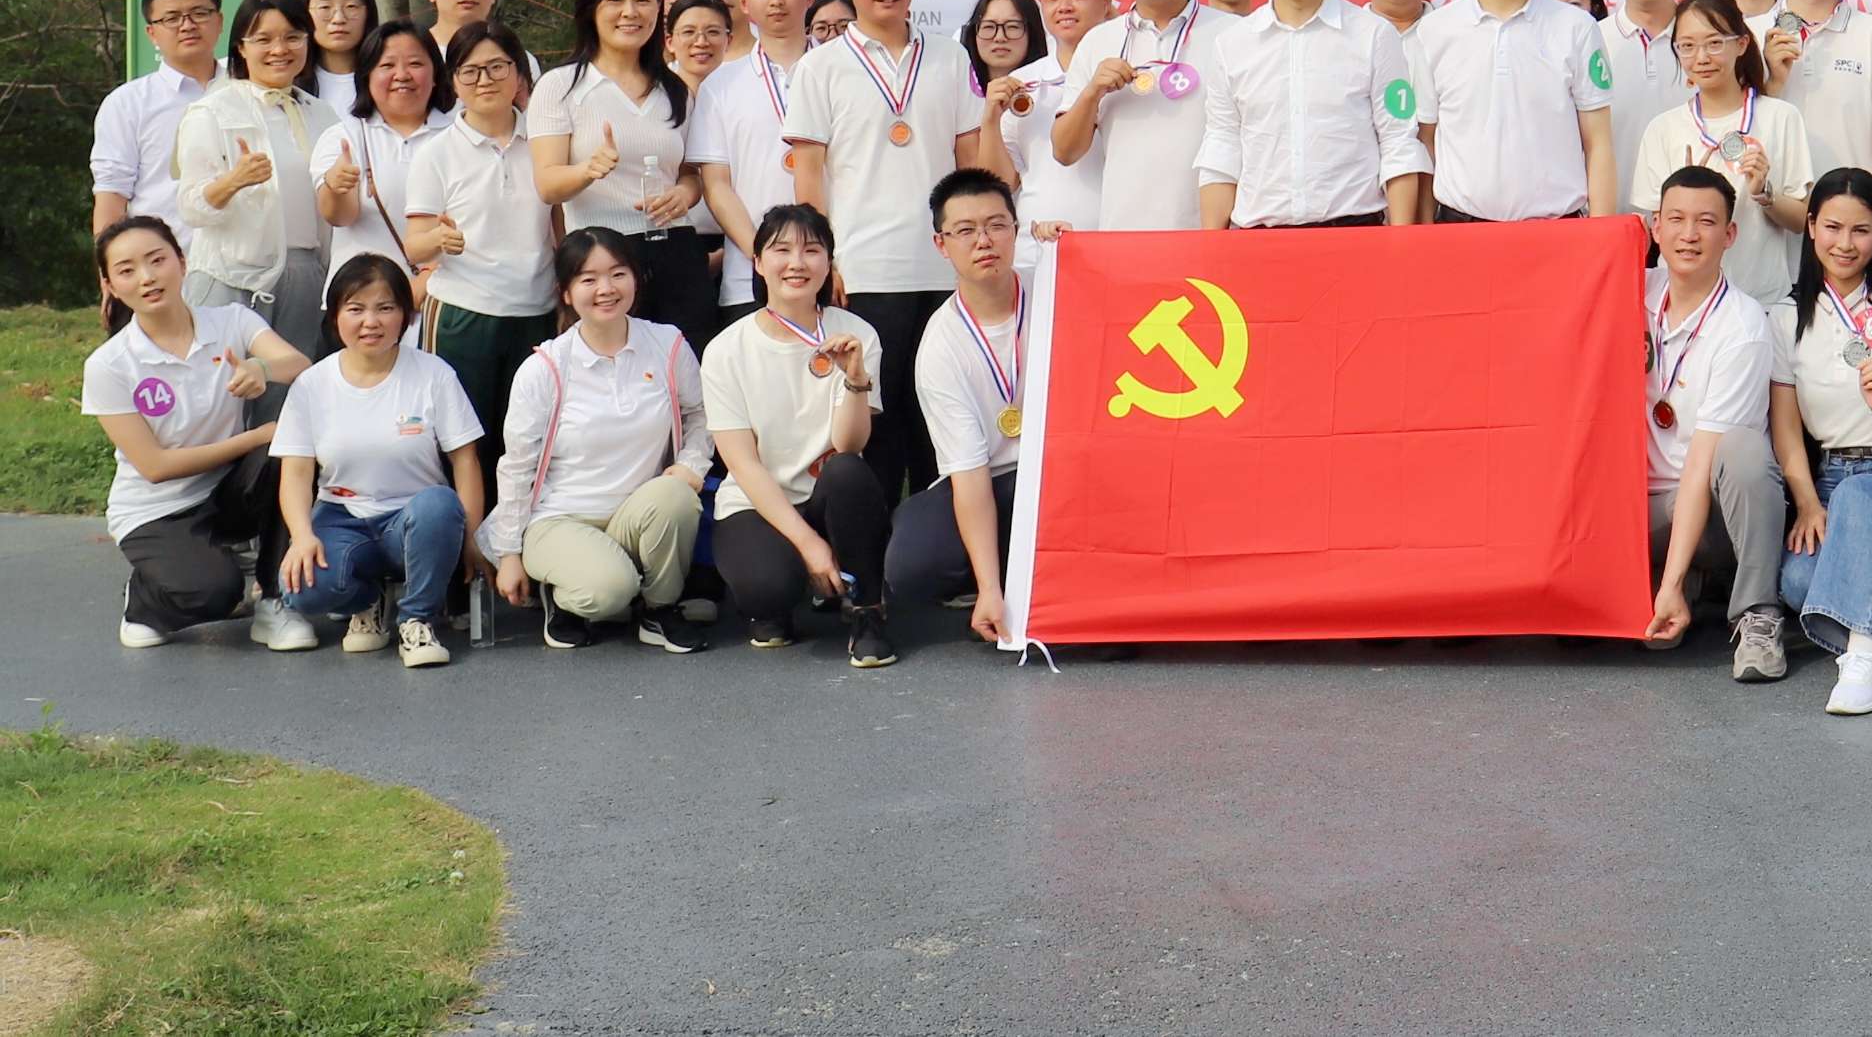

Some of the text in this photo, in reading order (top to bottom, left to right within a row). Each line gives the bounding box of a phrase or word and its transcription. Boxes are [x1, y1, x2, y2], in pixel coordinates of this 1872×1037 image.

[1169, 71, 1190, 91] 8
[1597, 57, 1609, 82] 2
[1397, 88, 1407, 111] 1
[138, 381, 171, 410] 14
